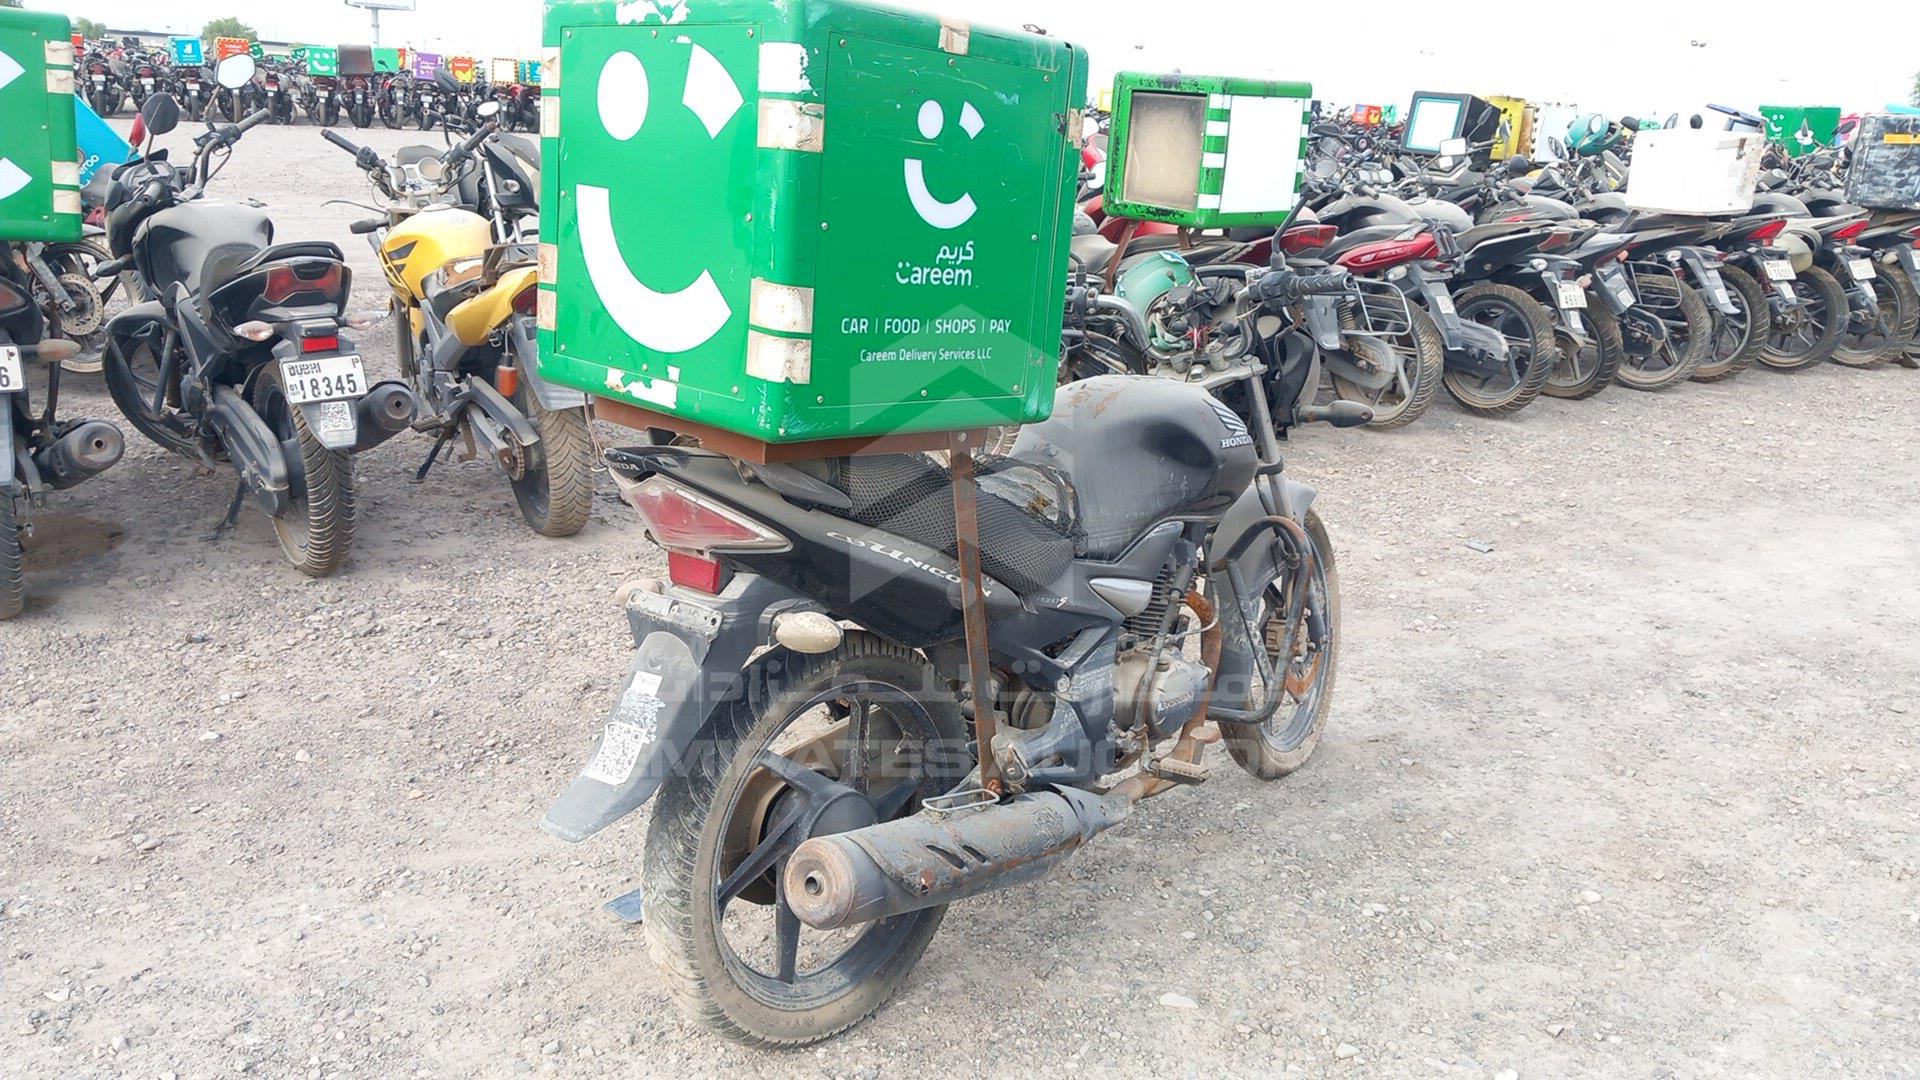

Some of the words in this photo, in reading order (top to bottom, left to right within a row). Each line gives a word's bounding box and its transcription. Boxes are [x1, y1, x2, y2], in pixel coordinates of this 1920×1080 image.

[936, 240, 975, 265] كريم
[895, 261, 972, 286] Careem
[841, 317, 869, 334] CAR
[884, 318, 920, 334] FOOD
[935, 318, 976, 334] SHOPS
[989, 318, 1012, 334] PAY
[860, 349, 897, 362] Careem
[899, 348, 937, 363] Delivery
[938, 347, 976, 360] Services
[977, 347, 992, 359] LLC
[299, 373, 357, 399] 18345
[1220, 435, 1253, 449] HONDA
